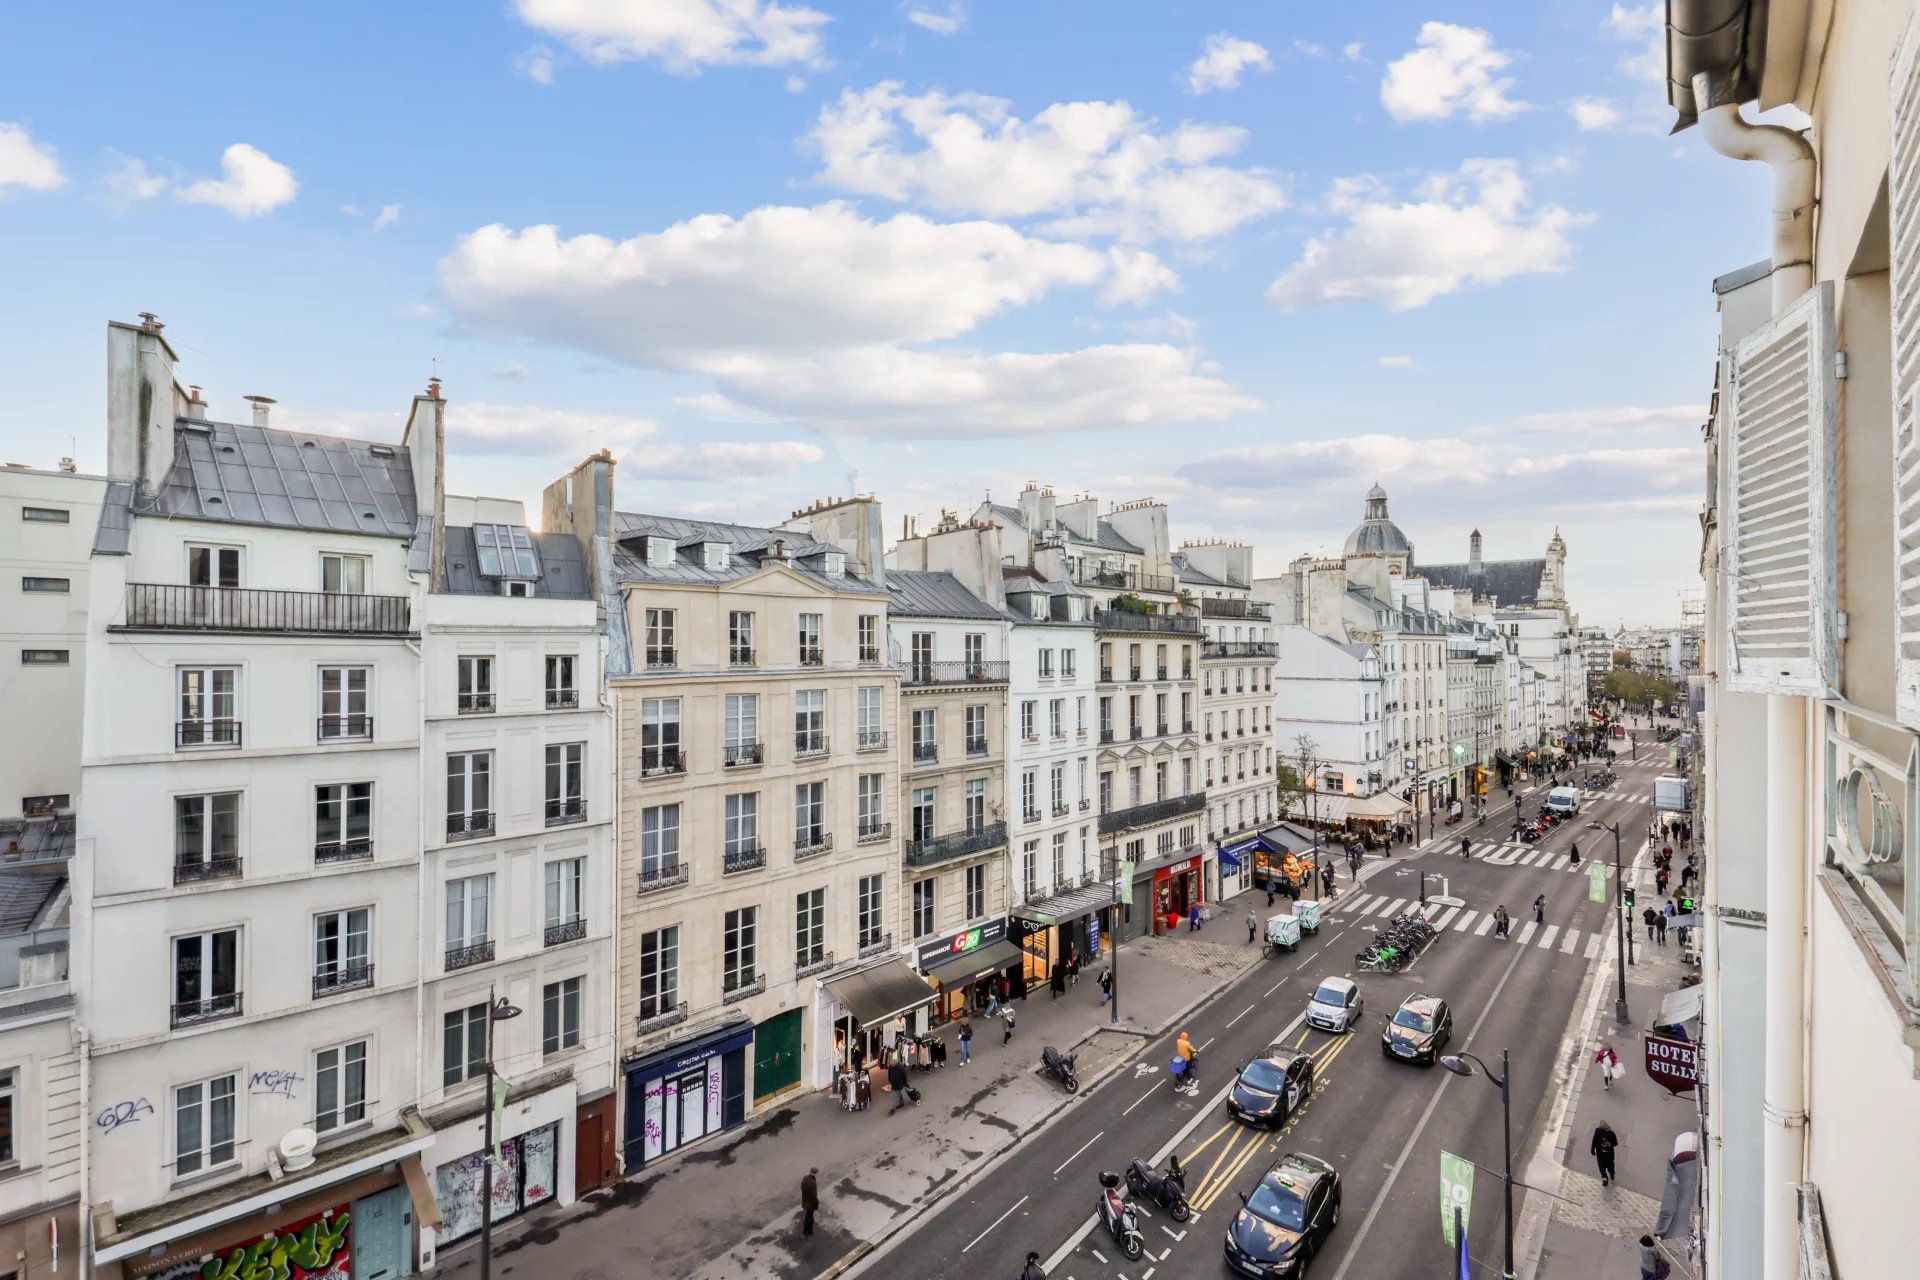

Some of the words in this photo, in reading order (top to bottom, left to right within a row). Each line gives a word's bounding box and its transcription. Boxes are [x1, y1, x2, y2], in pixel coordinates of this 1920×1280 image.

[955, 933, 978, 948] G20
[1651, 1060, 1698, 1080] SULLY
[1269, 1078, 1331, 1153] LIVRAISON
[1442, 1178, 1470, 1203] 10
